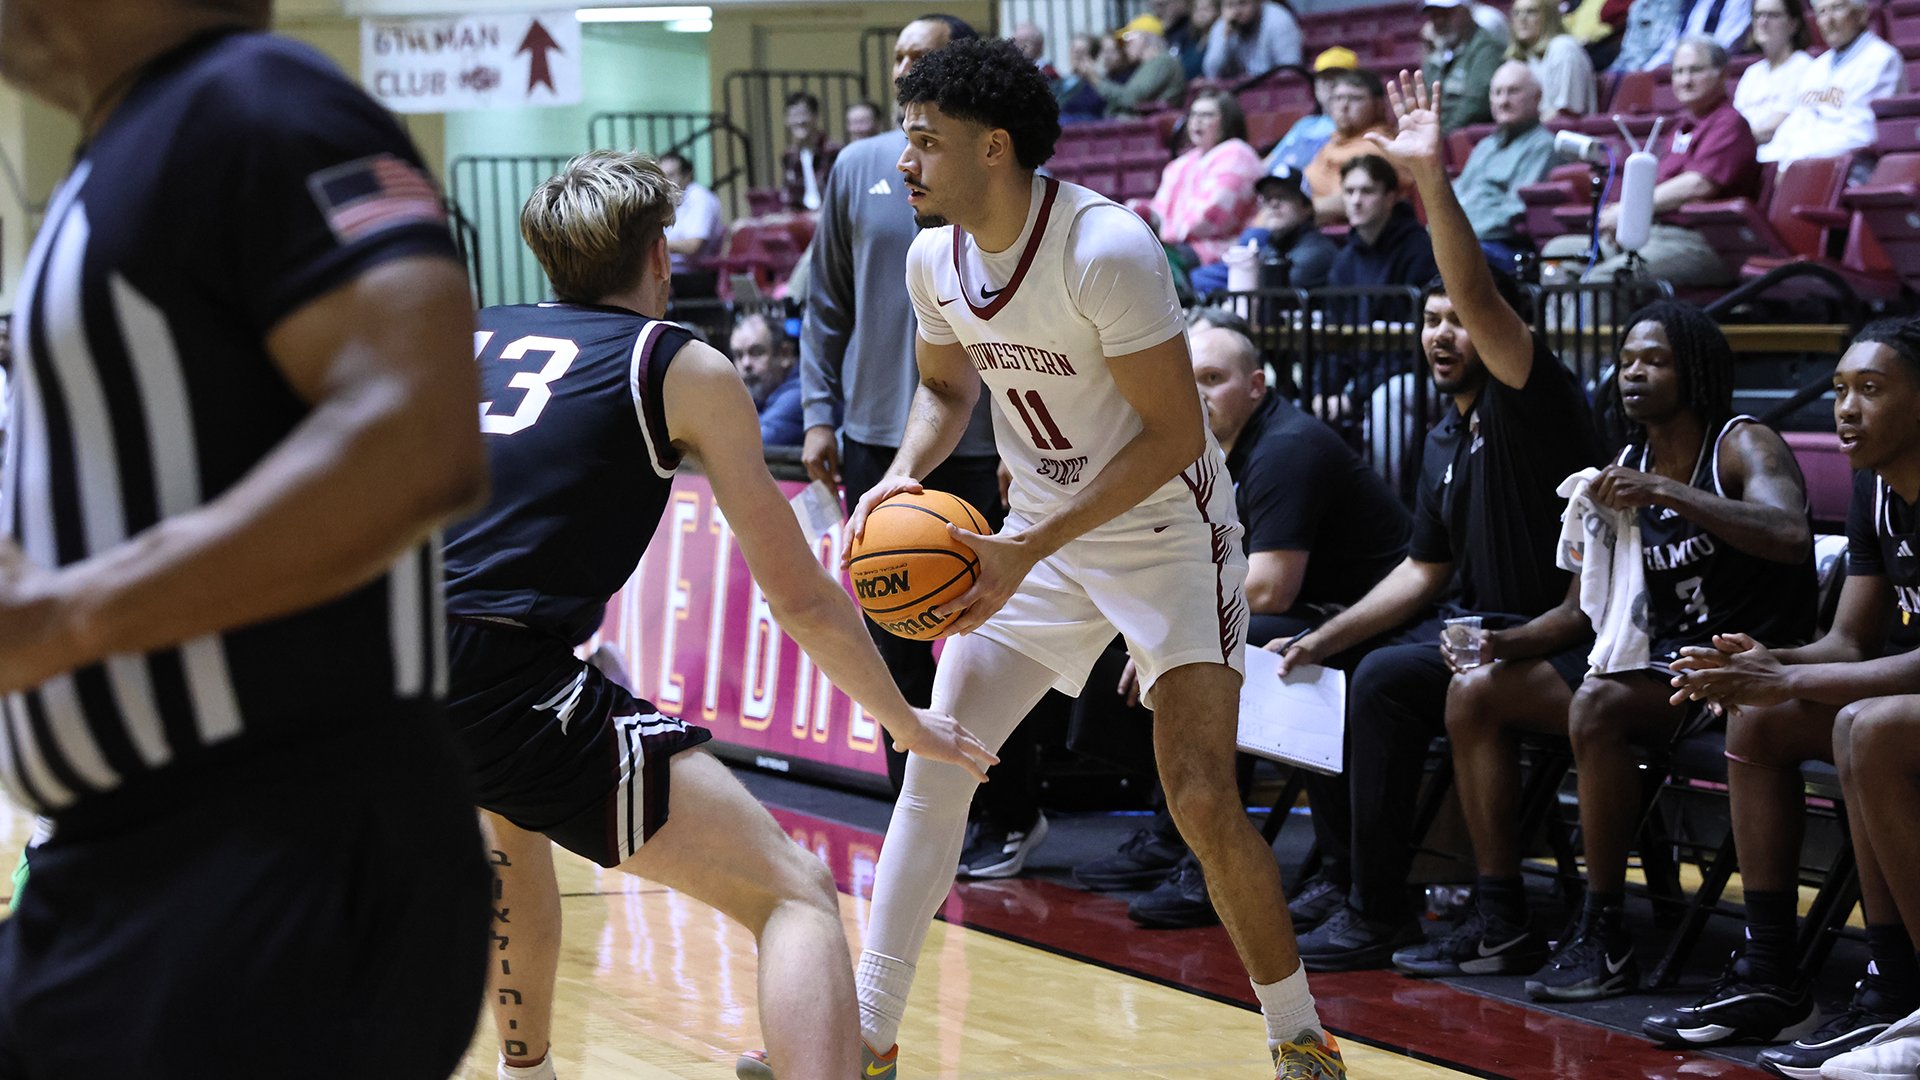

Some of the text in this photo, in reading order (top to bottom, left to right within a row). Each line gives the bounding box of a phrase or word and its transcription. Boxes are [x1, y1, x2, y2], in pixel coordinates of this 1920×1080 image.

[432, 24, 500, 50] MAN
[374, 70, 446, 97] CLUB
[1006, 388, 1074, 450] 11
[1036, 455, 1089, 486] STATE
[1642, 533, 1715, 570] TAMIU
[854, 569, 911, 599] NCAA
[1675, 576, 1709, 632] 3
